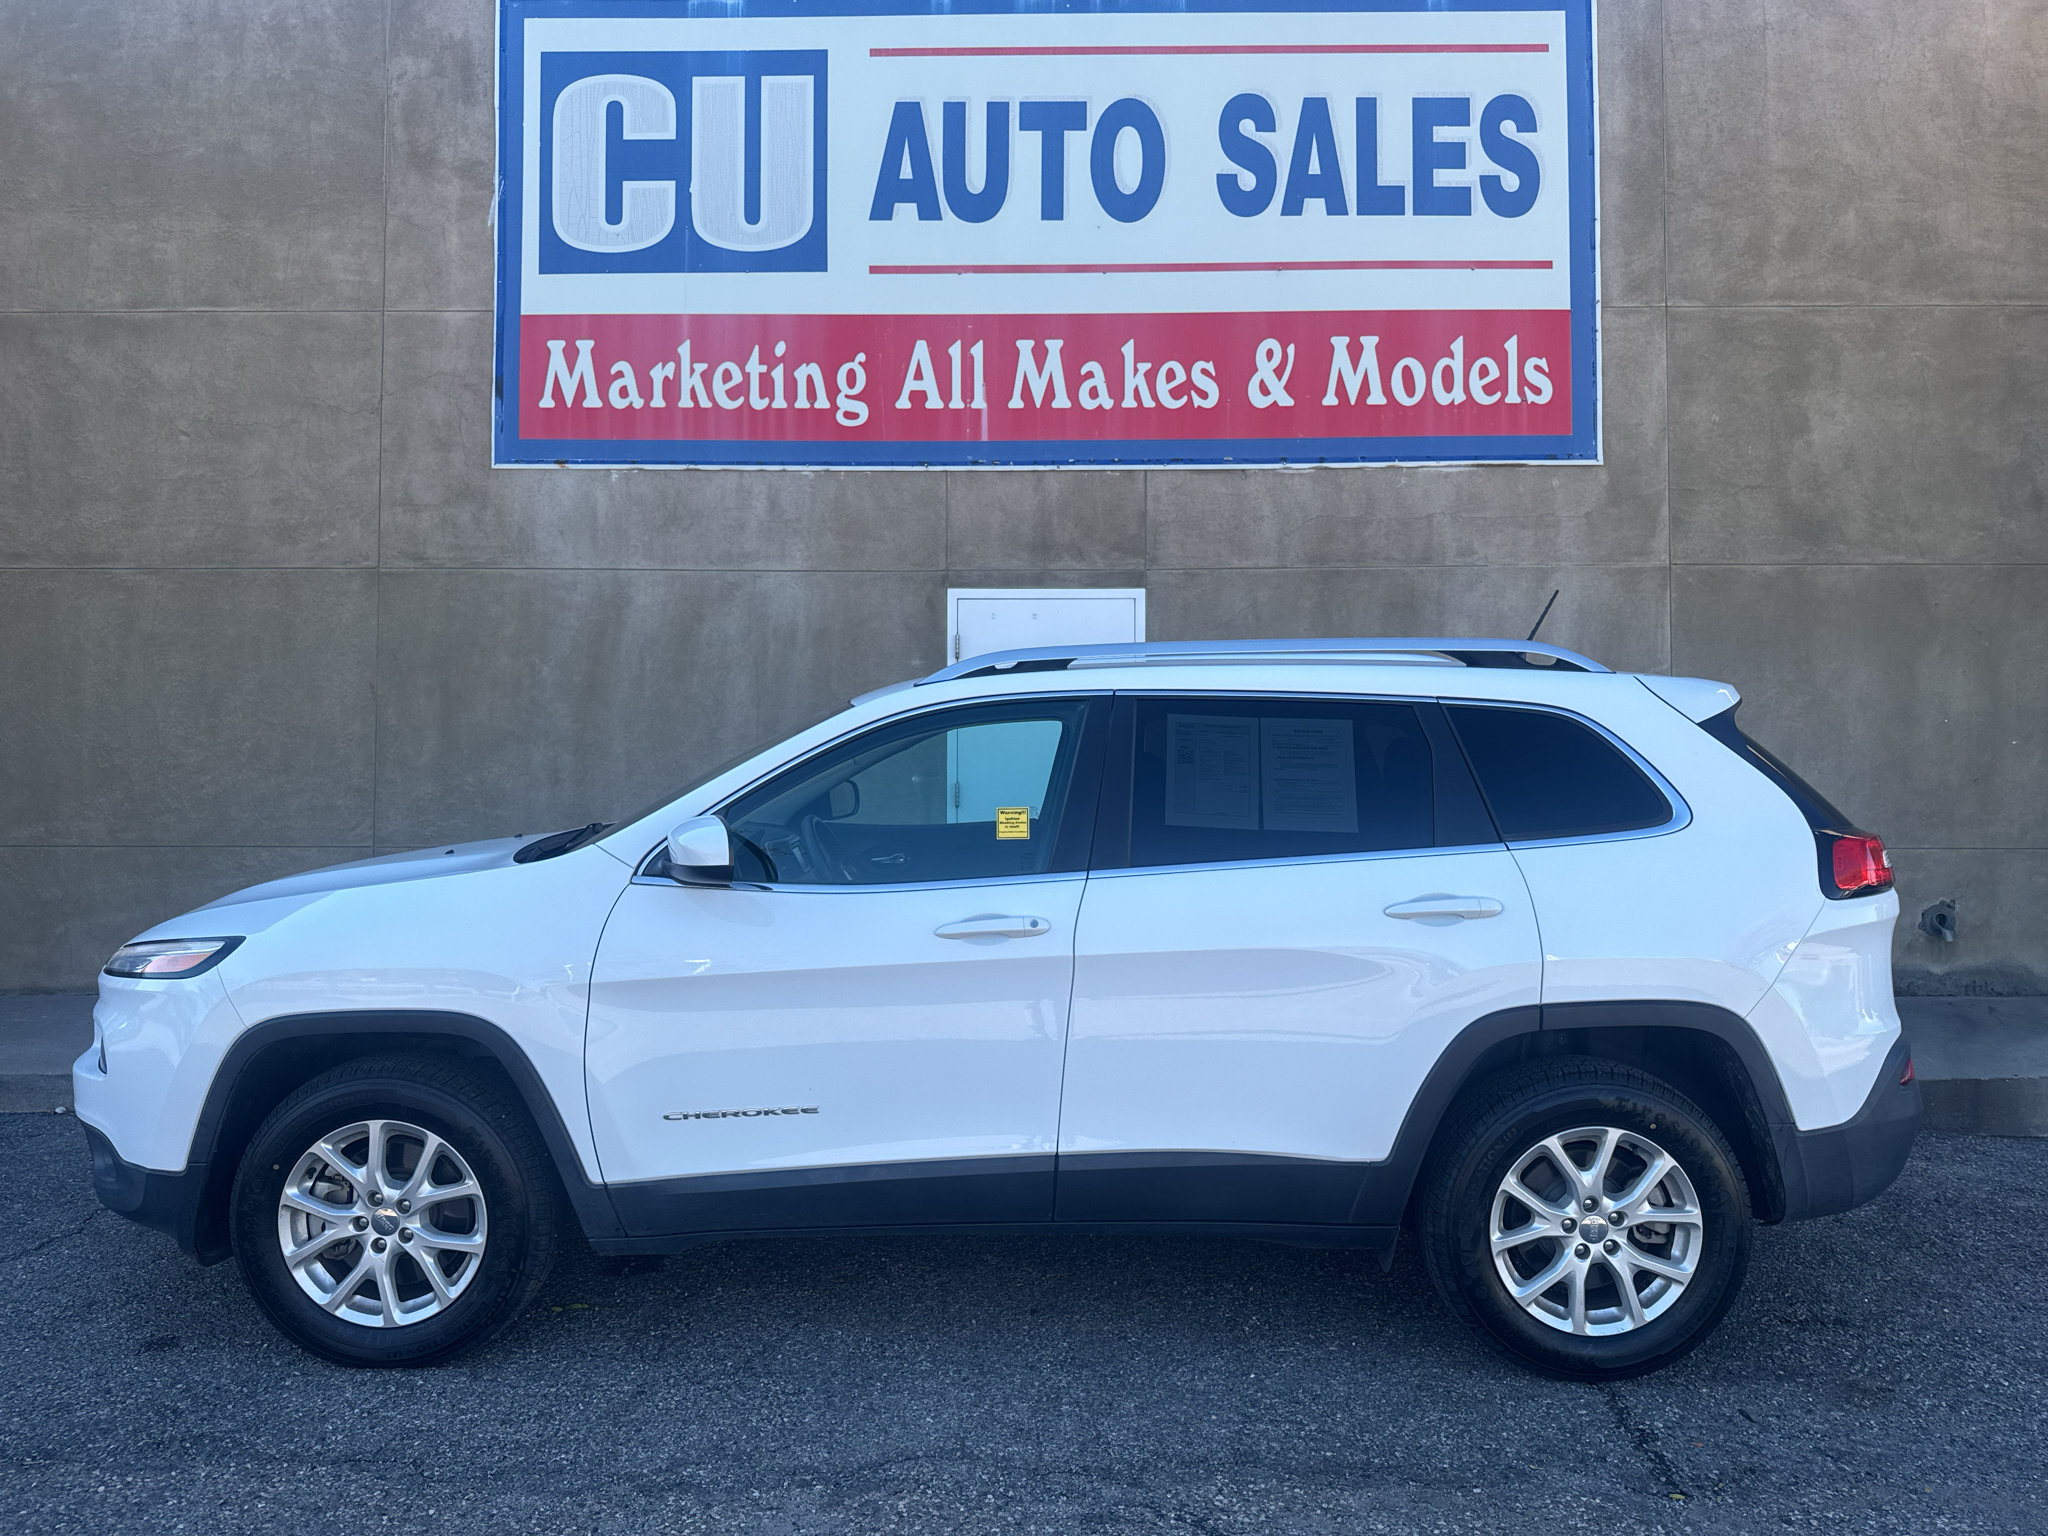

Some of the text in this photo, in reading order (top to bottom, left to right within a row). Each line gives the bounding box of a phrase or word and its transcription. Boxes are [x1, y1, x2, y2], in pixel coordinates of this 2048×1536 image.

[552, 74, 814, 253] CU
[868, 93, 1541, 223] AUTO SALES
[538, 334, 1554, 427] Marketing All Makes & Models
[663, 1105, 819, 1120] CHEROKEE
